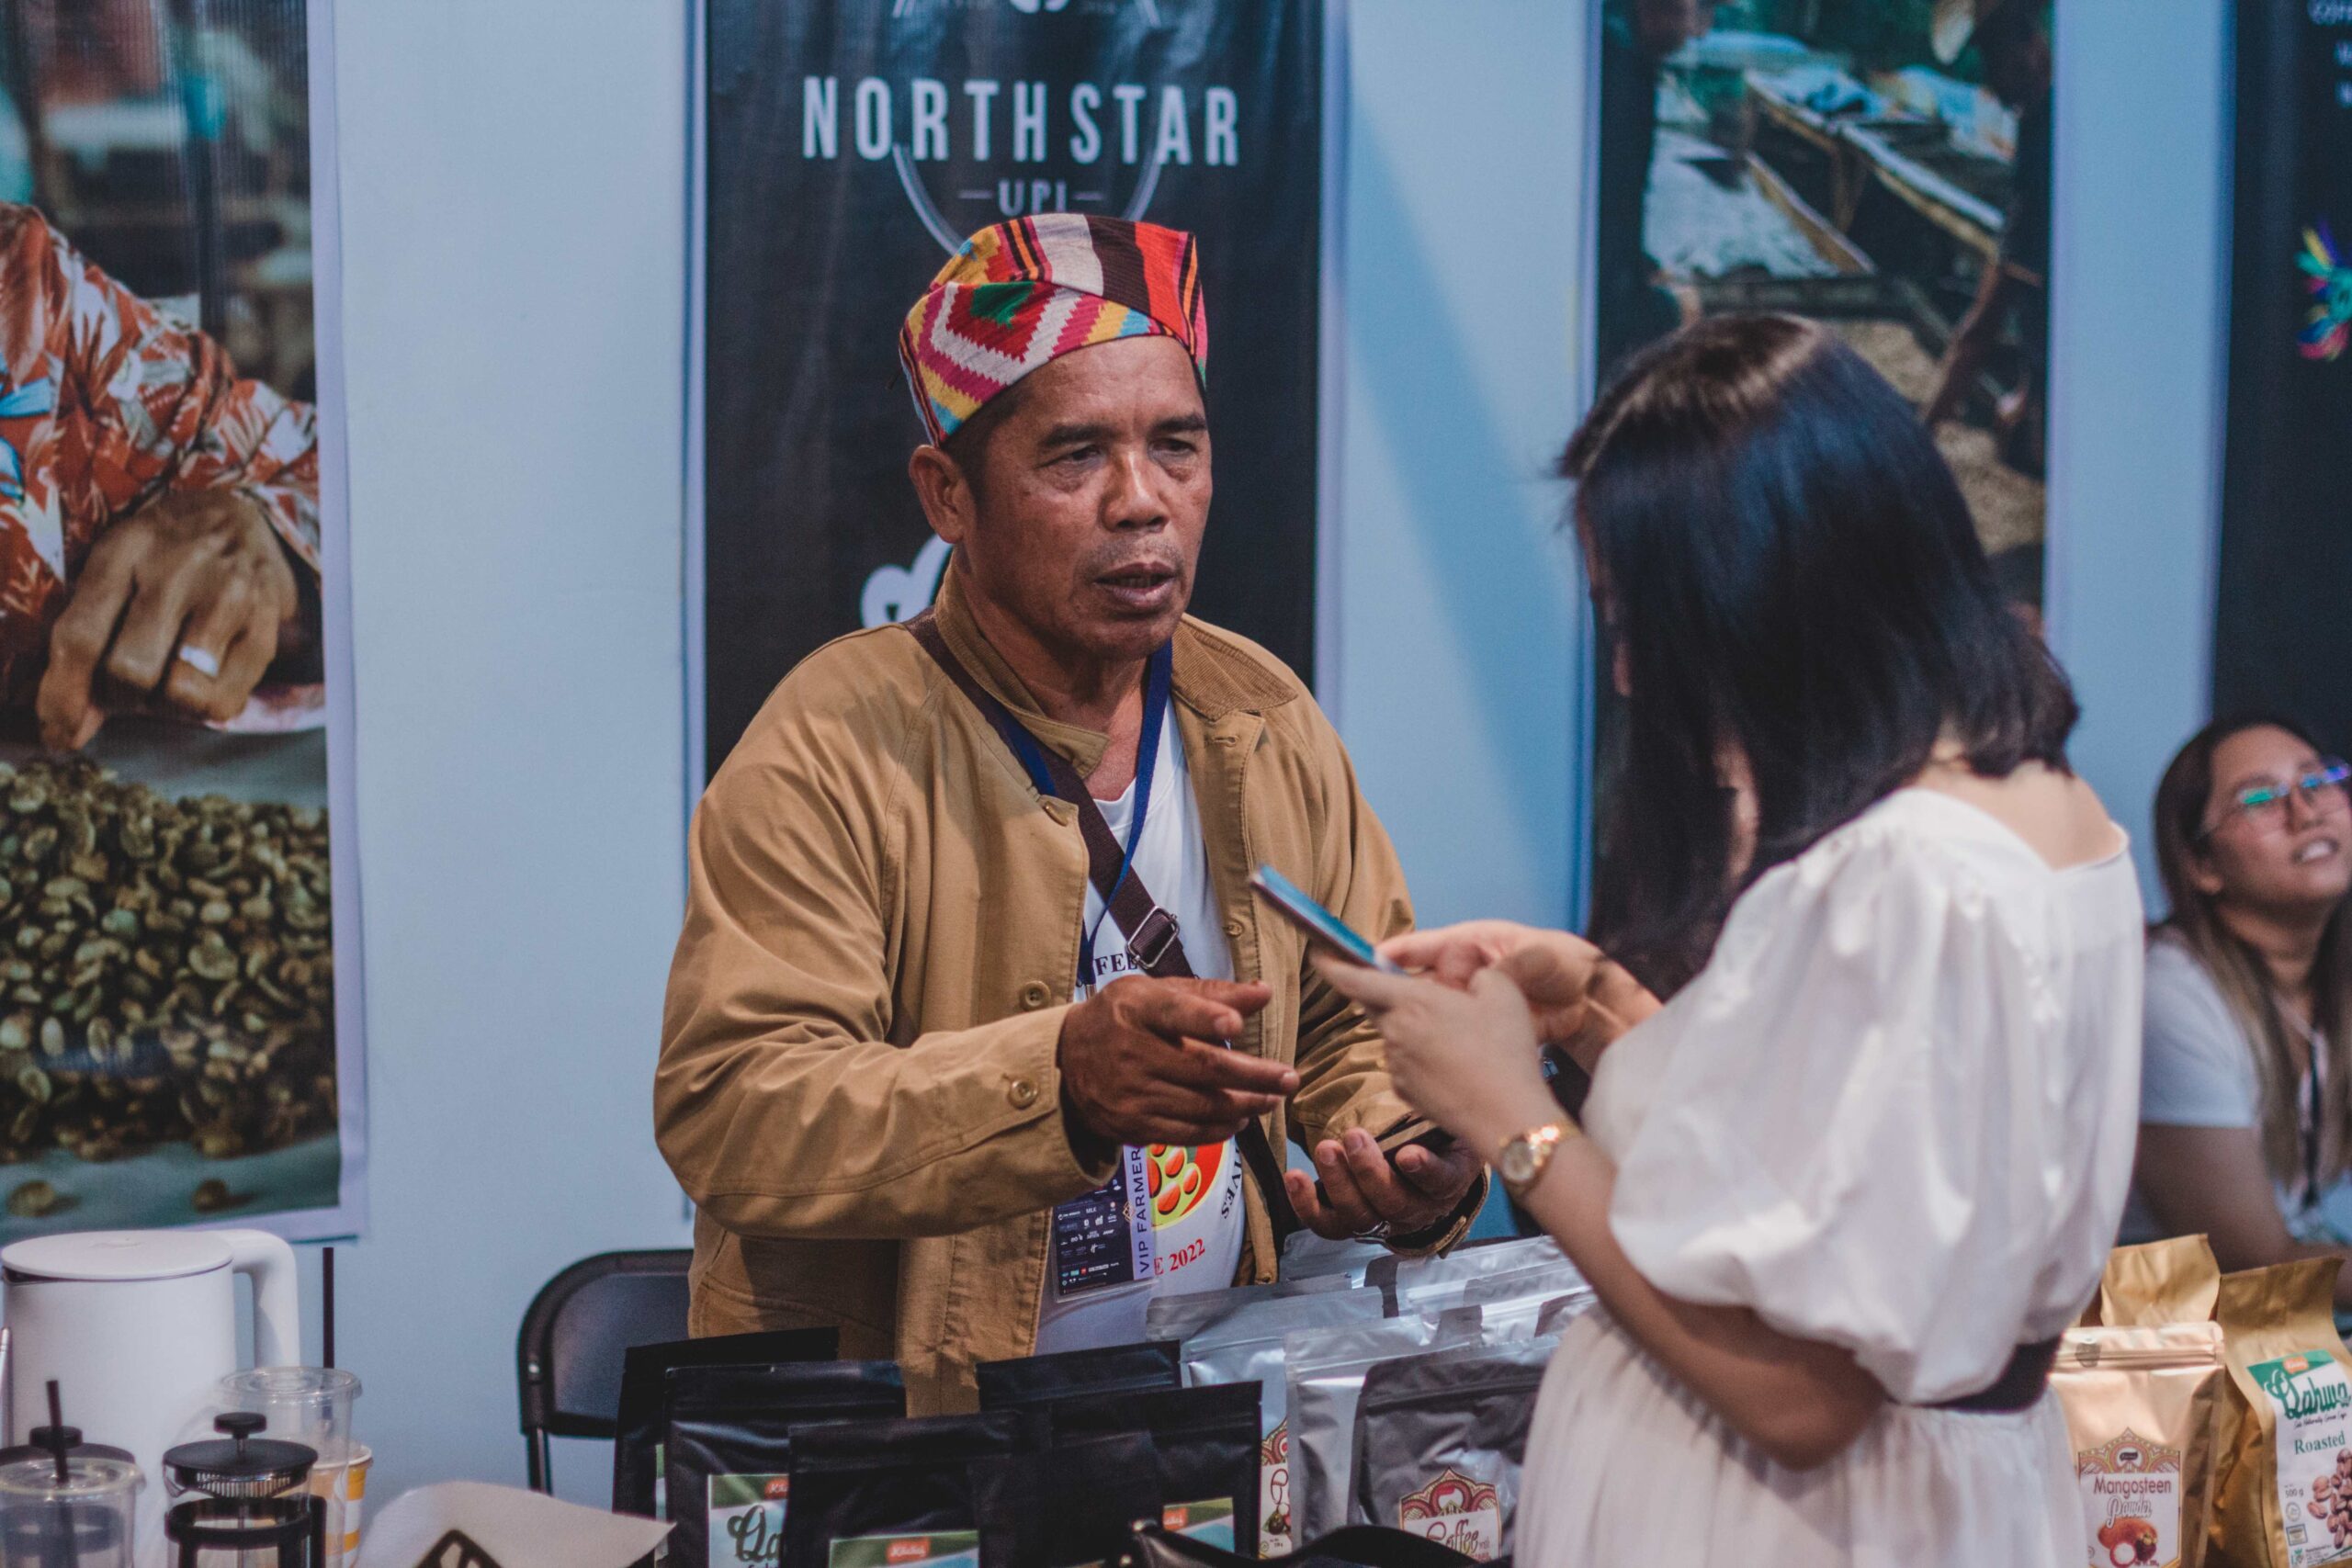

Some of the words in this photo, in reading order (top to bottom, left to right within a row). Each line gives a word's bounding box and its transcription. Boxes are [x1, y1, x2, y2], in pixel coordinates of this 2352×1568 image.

[802, 76, 1047, 163] NORTH
[1070, 82, 1238, 166] STAR
[1131, 1148, 1148, 1234] FARMER
[1138, 1241, 1150, 1273] VIP
[1170, 1238, 1205, 1272] 2022
[2264, 1369, 2351, 1419] Qahwa
[2294, 1429, 2346, 1455] Roasted
[2094, 1475, 2172, 1500] Mangosteen
